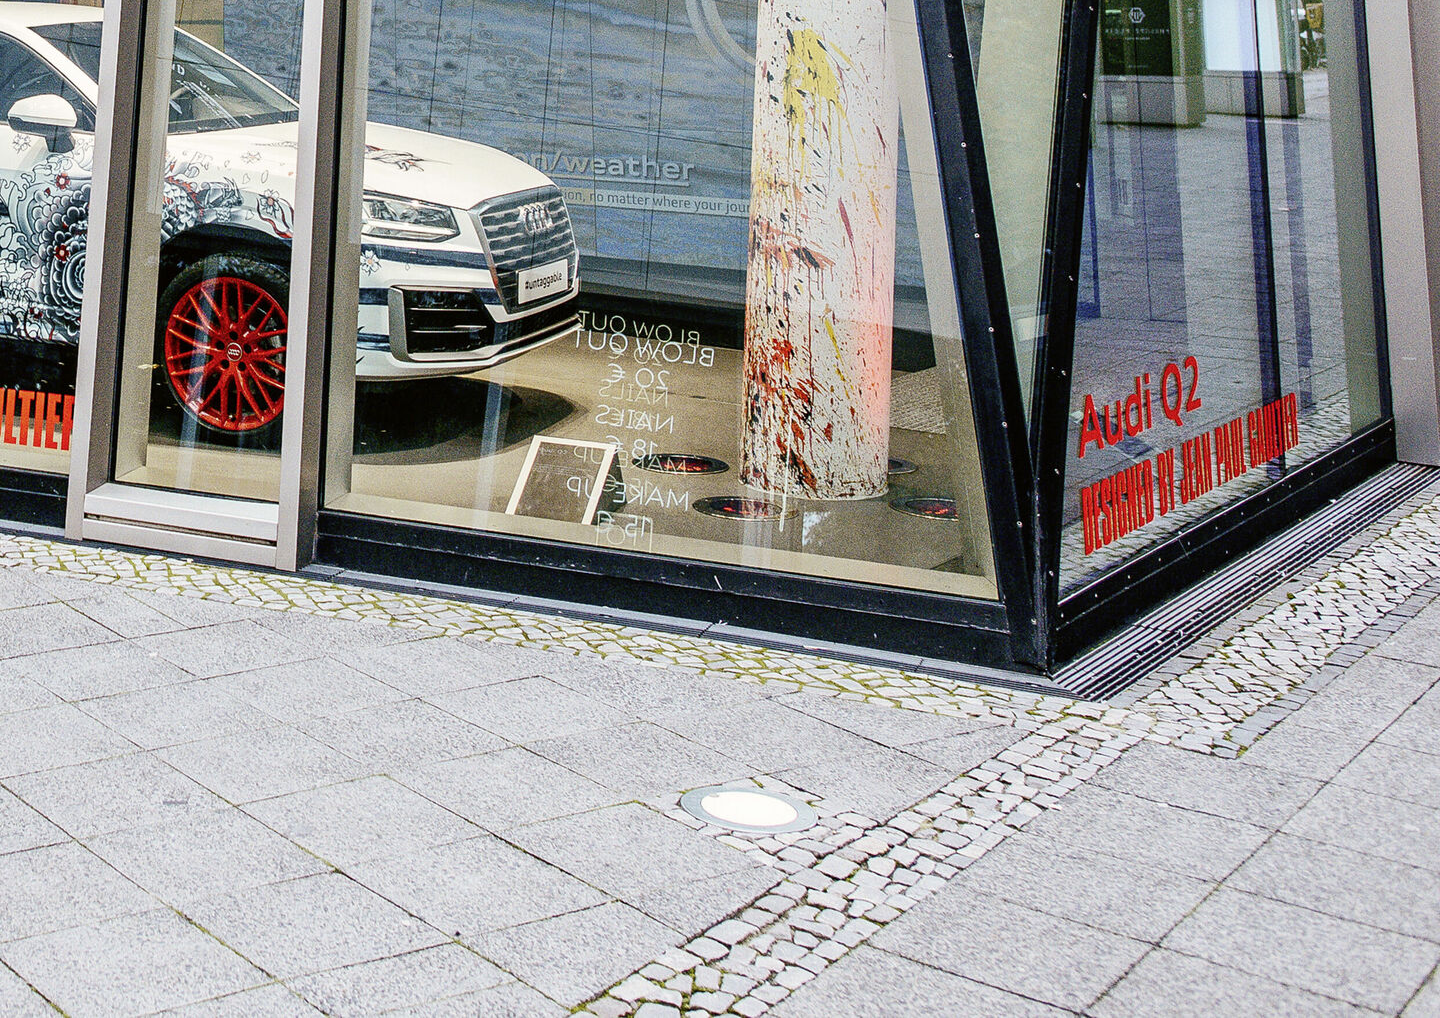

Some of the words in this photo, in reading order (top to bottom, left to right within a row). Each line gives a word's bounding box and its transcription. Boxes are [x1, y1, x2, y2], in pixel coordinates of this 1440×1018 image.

[590, 192, 604, 204] no
[607, 192, 650, 206] matter
[652, 196, 691, 210] where
[693, 199, 723, 213] your
[1077, 372, 1153, 459] Audi
[1160, 355, 1203, 426] Q2
[1081, 459, 1155, 556] DESIGNED
[1158, 447, 1176, 516] BY
[1180, 428, 1214, 505] JEAN
[1215, 417, 1247, 488] PAUL
[1248, 392, 1301, 467] GAULTIER
